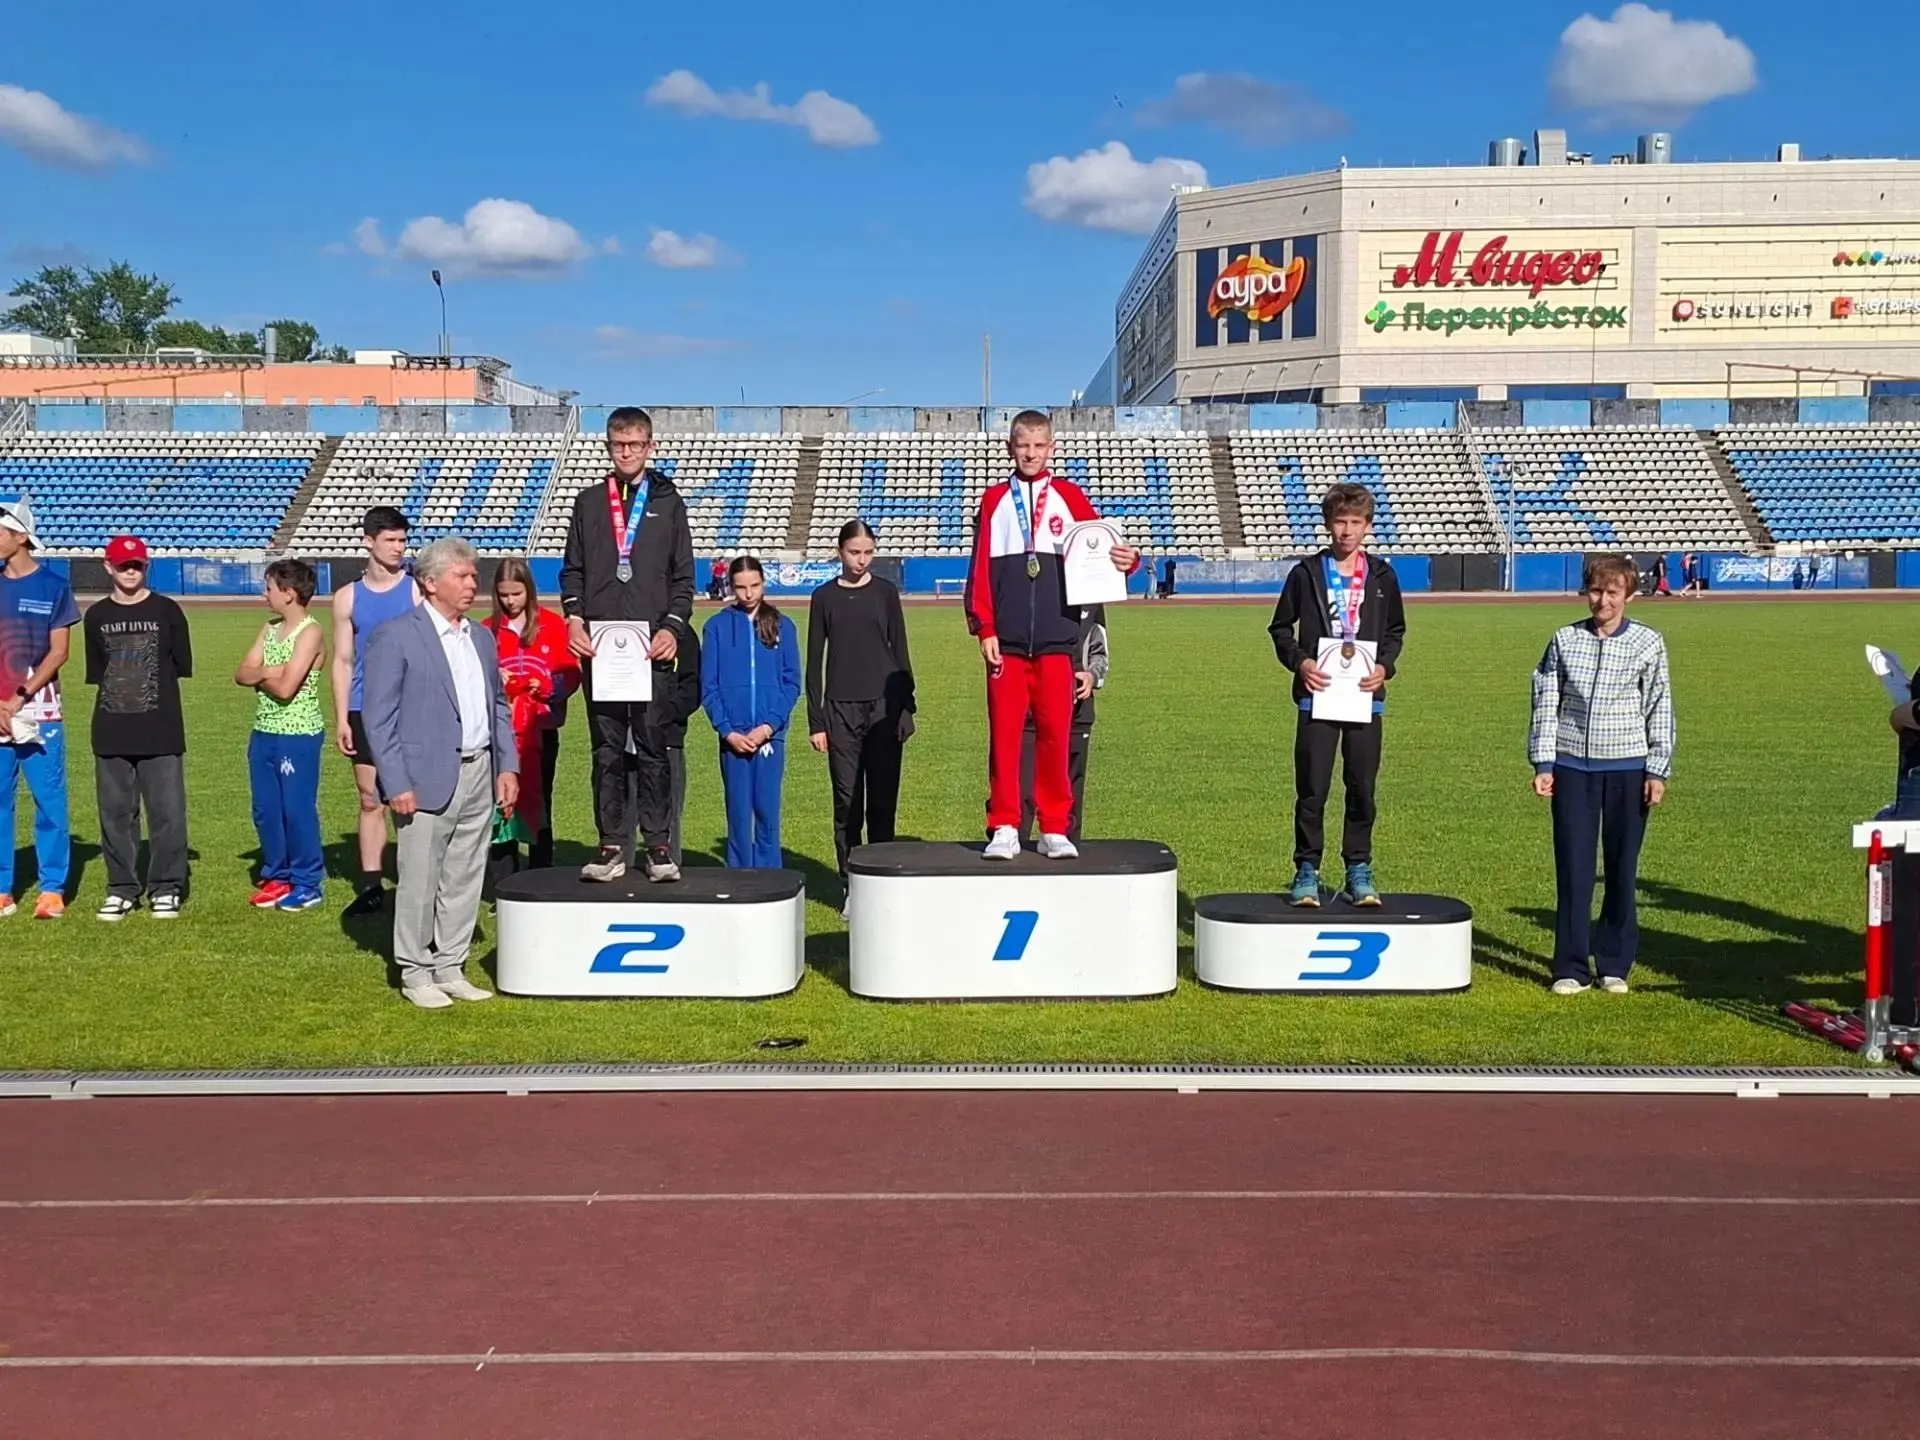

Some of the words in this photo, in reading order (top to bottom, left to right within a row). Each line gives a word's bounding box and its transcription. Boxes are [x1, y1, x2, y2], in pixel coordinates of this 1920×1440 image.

[1216, 271, 1287, 307] аура
[1403, 301, 1628, 336] Перекрёсток
[1697, 302, 1813, 319] SUNLIGHT
[100, 622, 127, 633] START
[129, 621, 159, 632] LIVING
[589, 924, 685, 973] 2
[992, 910, 1039, 961] 1
[1298, 931, 1390, 980] 3
